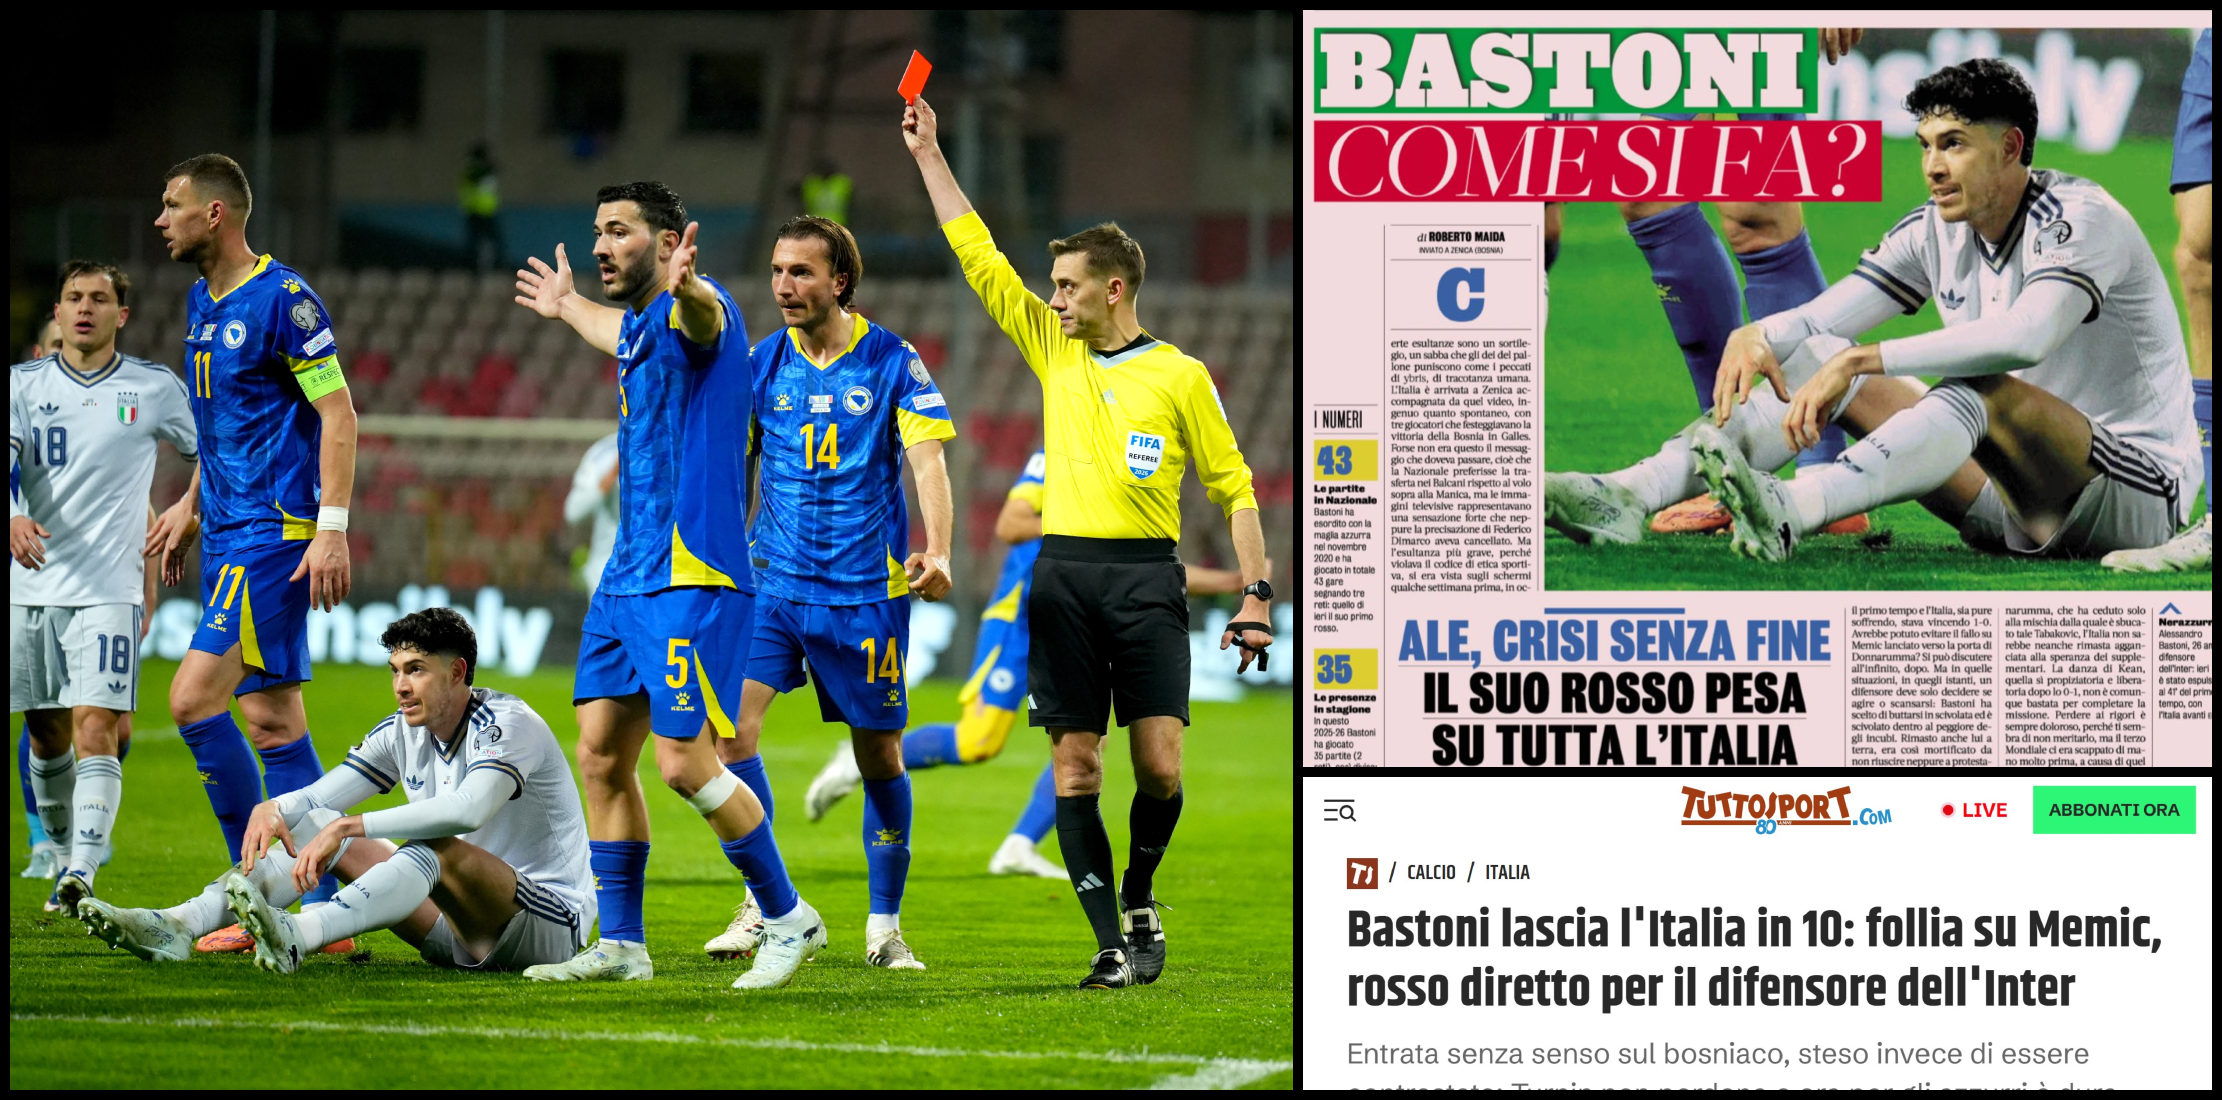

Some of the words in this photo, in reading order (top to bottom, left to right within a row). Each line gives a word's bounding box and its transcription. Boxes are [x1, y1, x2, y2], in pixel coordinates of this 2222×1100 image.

[1321, 33, 1803, 108] BASTONI
[1329, 125, 1598, 197] COME
[1611, 125, 1693, 197] SI
[1704, 123, 1866, 197] FA?
[1417, 233, 1427, 242] di
[1429, 231, 1472, 242] ROBERTO
[1474, 231, 1505, 242] MAIDA
[1437, 267, 1485, 322] C
[193, 351, 212, 398] 11
[319, 367, 341, 382] RESPEC
[1314, 410, 1317, 428] I
[1322, 410, 1362, 429] NUMERI
[1130, 434, 1161, 450] FIFA
[1390, 431, 1424, 442] vittoria
[1426, 430, 1450, 442] della
[1453, 431, 1485, 442] Bosnia
[1500, 430, 1532, 442] Galles.
[32, 426, 67, 466] 18
[799, 423, 841, 469] 14
[1128, 452, 1159, 463] REFEREE
[1317, 445, 1352, 475] 43
[1313, 483, 1327, 494] Le
[1328, 483, 1366, 496] partite
[1325, 495, 1378, 505] Nazionale
[1313, 507, 1344, 517] Bastoni
[1344, 507, 1355, 517] ha
[1313, 518, 1347, 529] esordito
[1348, 520, 1363, 528] con
[1364, 518, 1372, 528] la
[1313, 530, 1339, 542] maglia
[1340, 531, 1372, 540] azzurra
[1313, 542, 1326, 552] nel
[1327, 542, 1367, 552] novembre
[1313, 553, 1334, 563] 2020
[1341, 554, 1352, 563] ha
[1313, 565, 1343, 577] giocato
[1352, 565, 1376, 575] totale
[209, 564, 245, 609] 11
[1313, 576, 1324, 587] 43
[1325, 577, 1344, 588] gare
[1313, 588, 1352, 600] segnando
[1352, 588, 1366, 598] tre
[1313, 600, 1330, 610] reti:
[1331, 600, 1356, 611] quello
[1356, 600, 1365, 610] di
[2005, 607, 2054, 616] narumma,
[2056, 605, 2074, 616] che
[2077, 605, 2090, 616] ha
[2092, 605, 2124, 616] ceduto
[2126, 605, 2147, 616] solo
[1313, 611, 1327, 621] ieri
[1334, 613, 1349, 621] suo
[1350, 611, 1374, 623] primo
[207, 622, 227, 633] KELME
[1313, 624, 1339, 633] rosso.
[2158, 629, 2203, 639] Alessandro
[1851, 628, 1889, 639] Avrebbe
[1889, 629, 1920, 641] potuto
[1920, 629, 1952, 639] evitare
[1960, 628, 1981, 639] fallo
[1981, 630, 1993, 639] su
[1399, 620, 1481, 669] ALE,
[1493, 619, 1598, 662] CRISI
[1610, 619, 1736, 662] SENZA
[1747, 620, 1831, 661] FINE
[98, 634, 130, 674] 18
[861, 637, 900, 684] 14
[2158, 652, 2196, 662] difensore
[665, 638, 691, 689] 5
[1317, 654, 1352, 684] 35
[2196, 664, 2210, 674] ieri
[1313, 692, 1327, 703] Le
[1328, 694, 1377, 705] presenze
[1424, 672, 1458, 713] IL
[1469, 671, 1550, 714] SUO
[1561, 671, 1694, 714] ROSSO
[1706, 671, 1807, 714] PESA
[1325, 704, 1372, 716] stagione
[2158, 699, 2186, 710] tempo,
[2187, 700, 2203, 709] con
[1313, 716, 1321, 726] In
[1322, 716, 1350, 727] questo
[1313, 727, 1346, 738] 2025-26
[1346, 727, 1377, 738] Bastoni
[1313, 739, 1324, 749] ha
[1325, 739, 1355, 751] giocato
[1432, 723, 1484, 767] SU
[1496, 724, 1625, 767] TUTTA
[1313, 750, 1324, 761] 35
[1324, 751, 1352, 762] partite
[1352, 750, 1363, 762] (2
[1682, 786, 1851, 819] TUTTOSPORT
[79, 803, 110, 816] ITALIA
[1963, 803, 2007, 817] LIVE
[2049, 804, 2139, 816] ABBONATI
[2144, 804, 2180, 816] ORA
[1756, 819, 1777, 834] 80
[872, 839, 904, 847] KELME
[1408, 865, 1455, 879] CALCIO
[1486, 865, 1530, 879] ITALIA
[1349, 906, 1489, 947] Bastoni
[1502, 906, 1608, 947] lascia
[1621, 906, 1745, 947] l'Italia
[1758, 906, 1791, 947] in
[1803, 910, 1854, 947] 10:
[1866, 906, 1963, 947] follia
[1974, 916, 2016, 947] su
[2029, 906, 2161, 953] Memic,
[1349, 974, 1448, 1006] rosso
[1461, 966, 1590, 1006] diretto
[1602, 974, 1663, 1014] per
[1674, 966, 1696, 1006] il
[1709, 966, 1886, 1006] difensore
[1898, 965, 2076, 1006] dell'Inter
[1349, 1043, 1439, 1064] Entrata
[1448, 1048, 1523, 1064] senza
[1532, 1048, 1609, 1064] senso
[1618, 1042, 1656, 1064] sul
[1665, 1042, 1789, 1068] bosniaco,
[1799, 1045, 1868, 1064] steso
[1877, 1042, 1962, 1064] invece
[1971, 1042, 1992, 1064] di
[2002, 1048, 2089, 1064] essere
